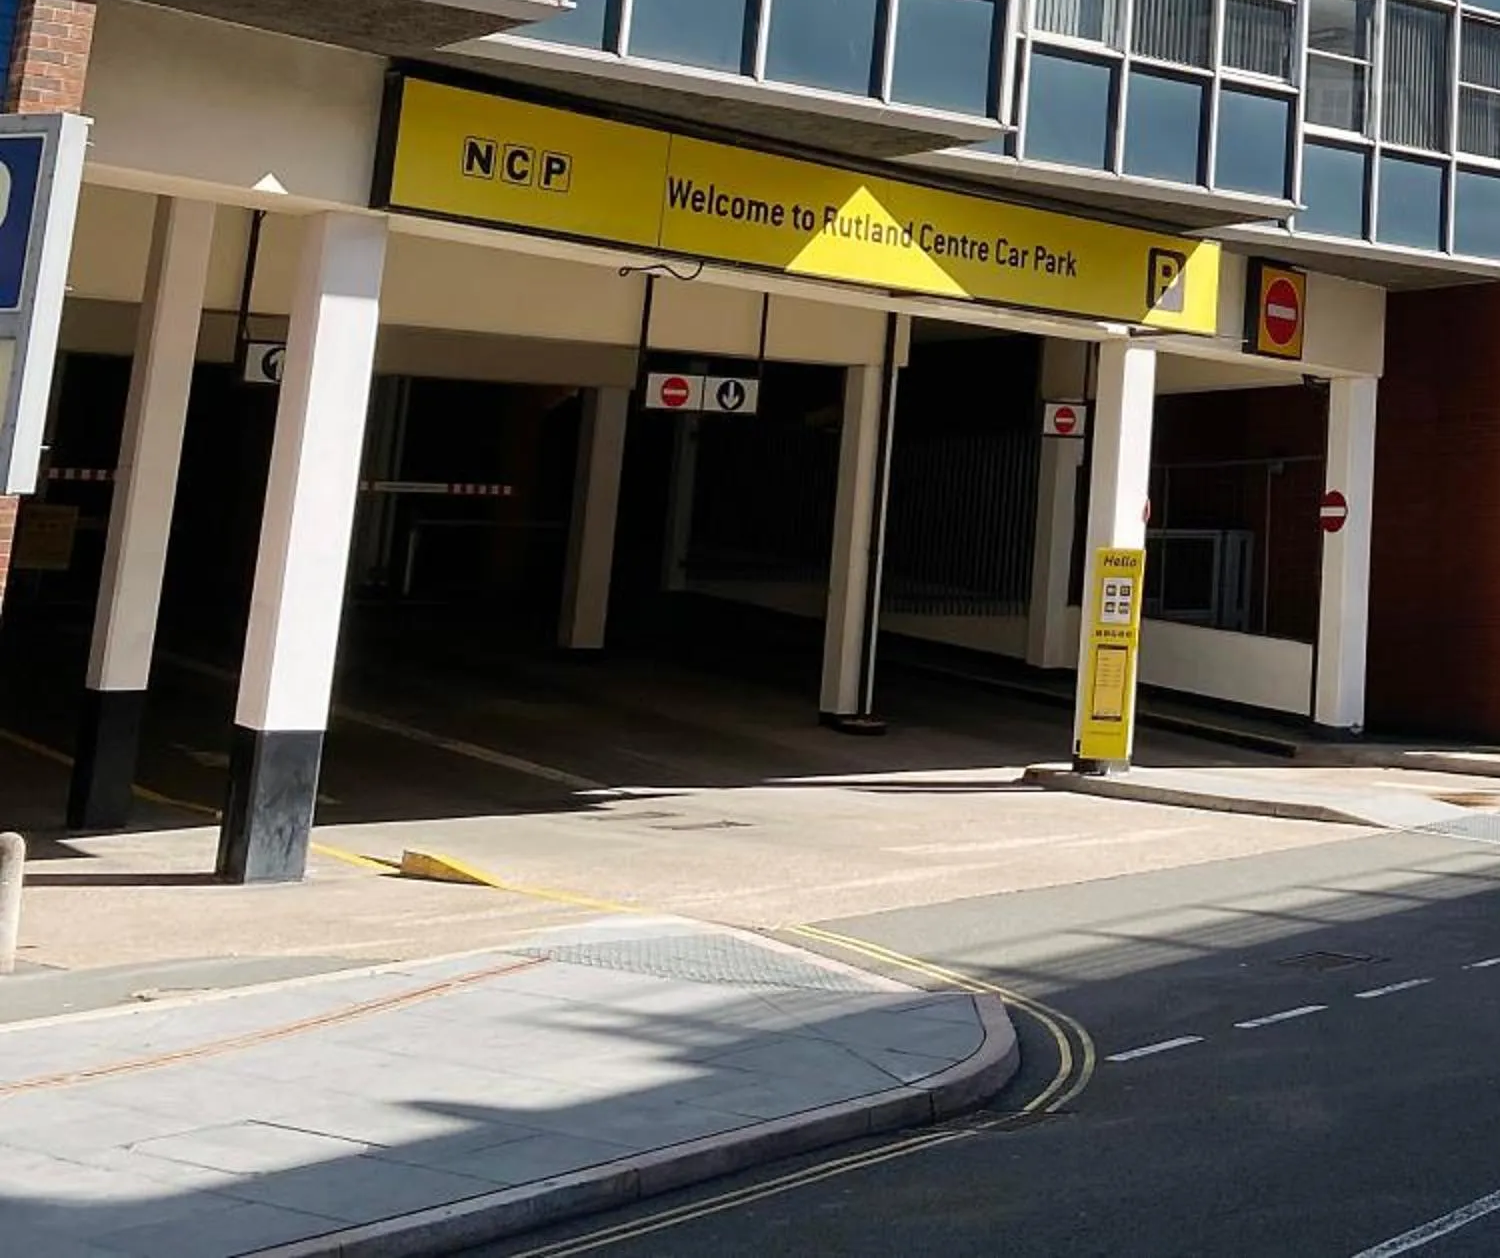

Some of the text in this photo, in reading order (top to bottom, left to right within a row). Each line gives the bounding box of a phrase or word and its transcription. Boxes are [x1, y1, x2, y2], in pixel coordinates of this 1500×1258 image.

[464, 138, 571, 190] NCP
[668, 176, 1078, 278] Welcome to Rutland Centre Car Park
